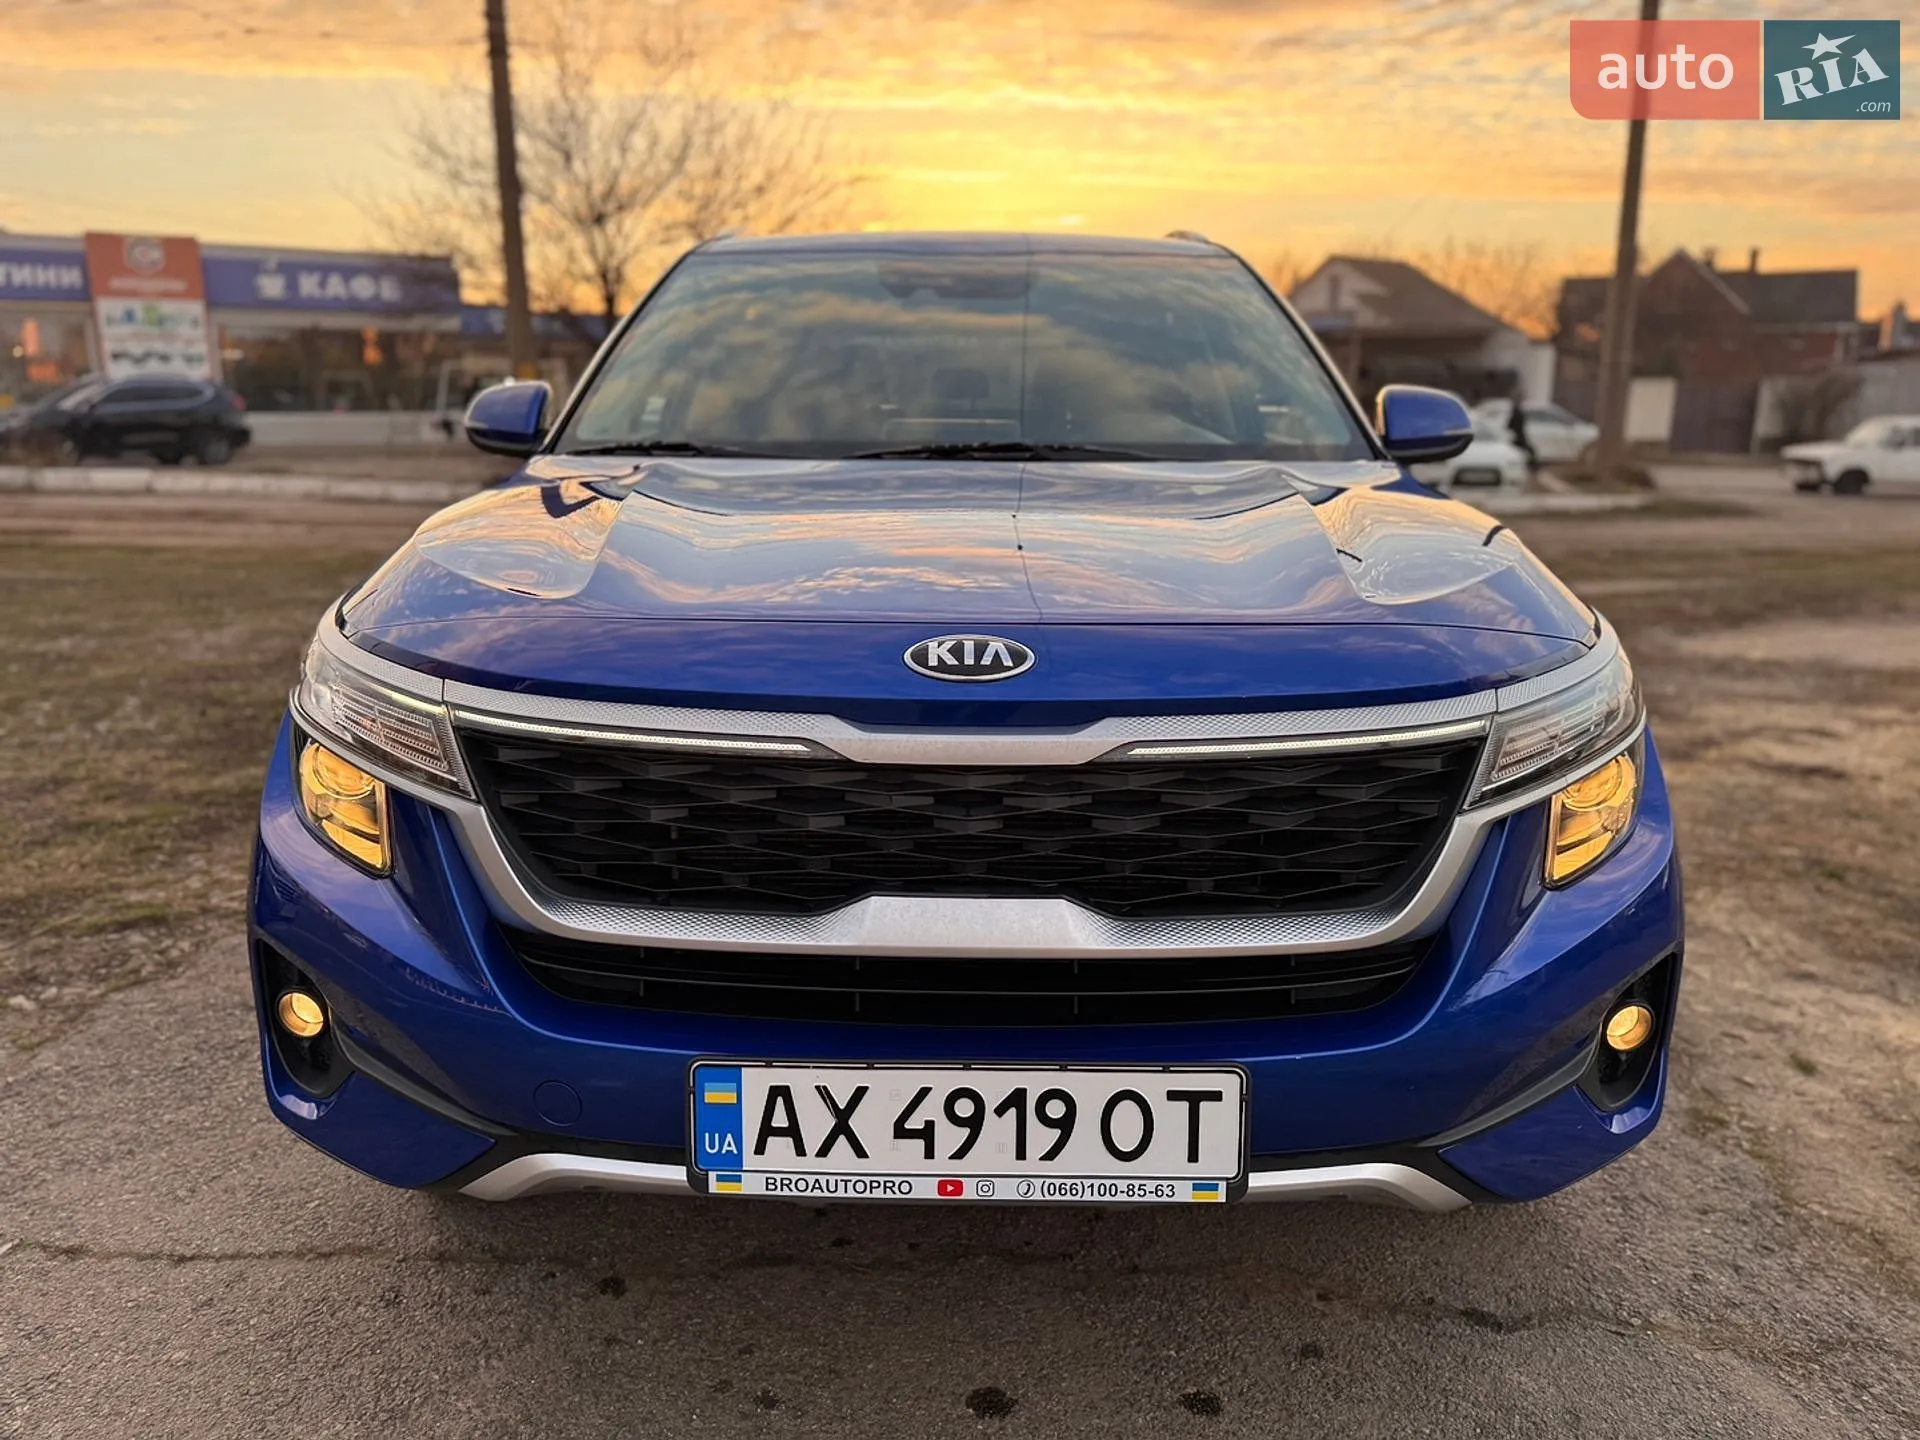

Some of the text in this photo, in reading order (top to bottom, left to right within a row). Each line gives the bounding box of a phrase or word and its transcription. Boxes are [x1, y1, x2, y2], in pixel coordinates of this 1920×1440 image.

[927, 640, 1014, 667] KIA
[753, 1084, 1223, 1164] AX 4919 OT
[704, 1132, 738, 1154] UA
[764, 1176, 1176, 1198] BROAUTOPRO (066)100-85-63
